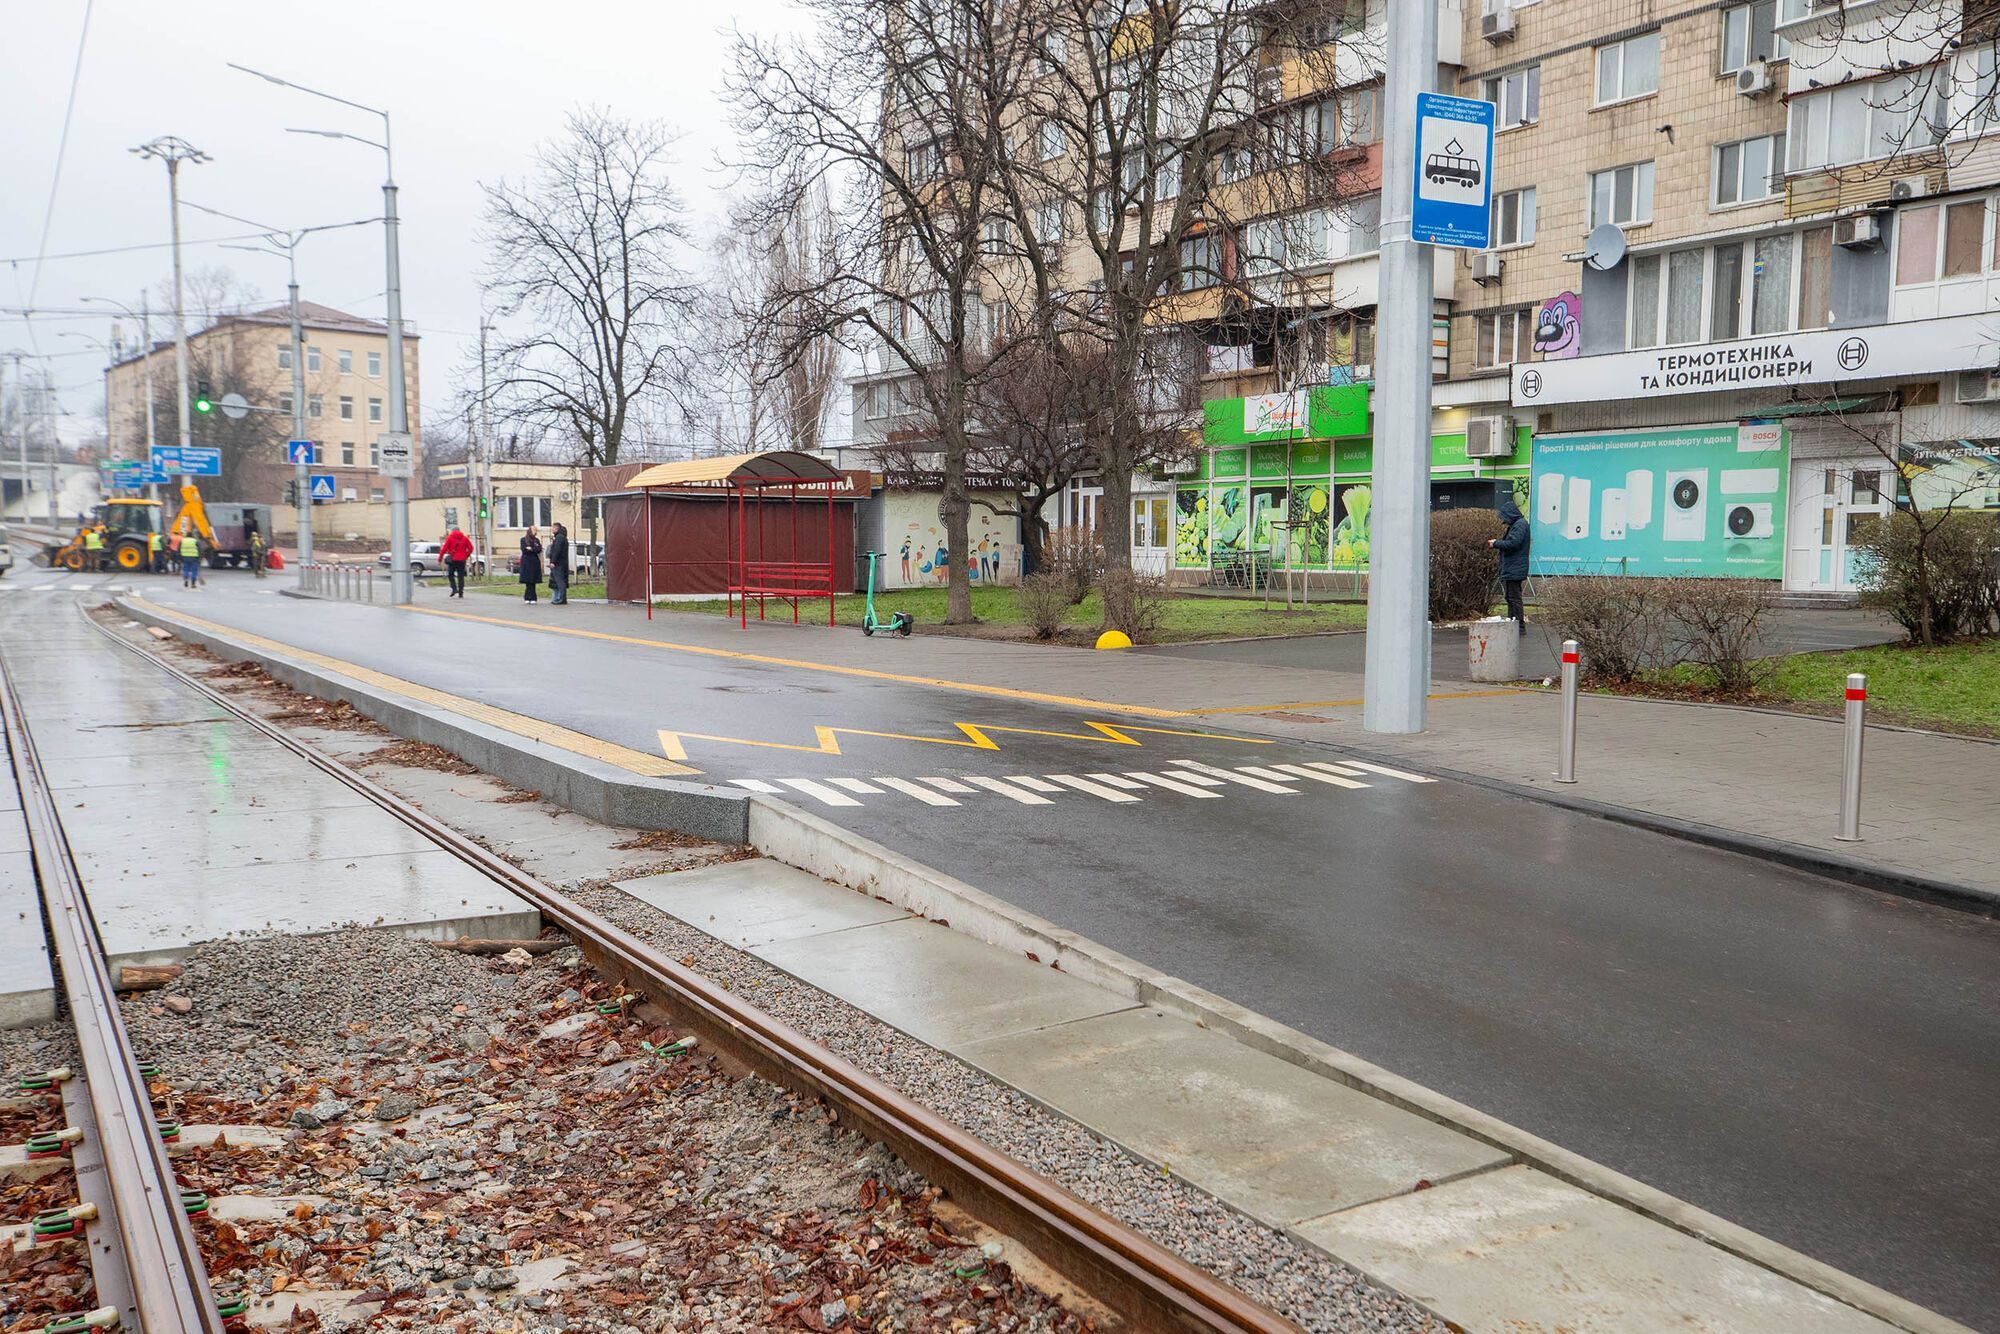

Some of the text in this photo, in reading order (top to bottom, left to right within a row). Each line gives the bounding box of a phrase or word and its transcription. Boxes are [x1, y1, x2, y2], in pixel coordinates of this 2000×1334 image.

[1658, 344, 1794, 370] ТЕРМОТЕХНІКА
[1640, 360, 1812, 389] ТА КОНДИЦІОНЕРИ
[1540, 444, 1564, 453] Прості
[1576, 441, 1604, 451] надійні
[1605, 441, 1638, 451] рішення
[1658, 436, 1701, 447] комфорту
[1704, 436, 1732, 444] вдома
